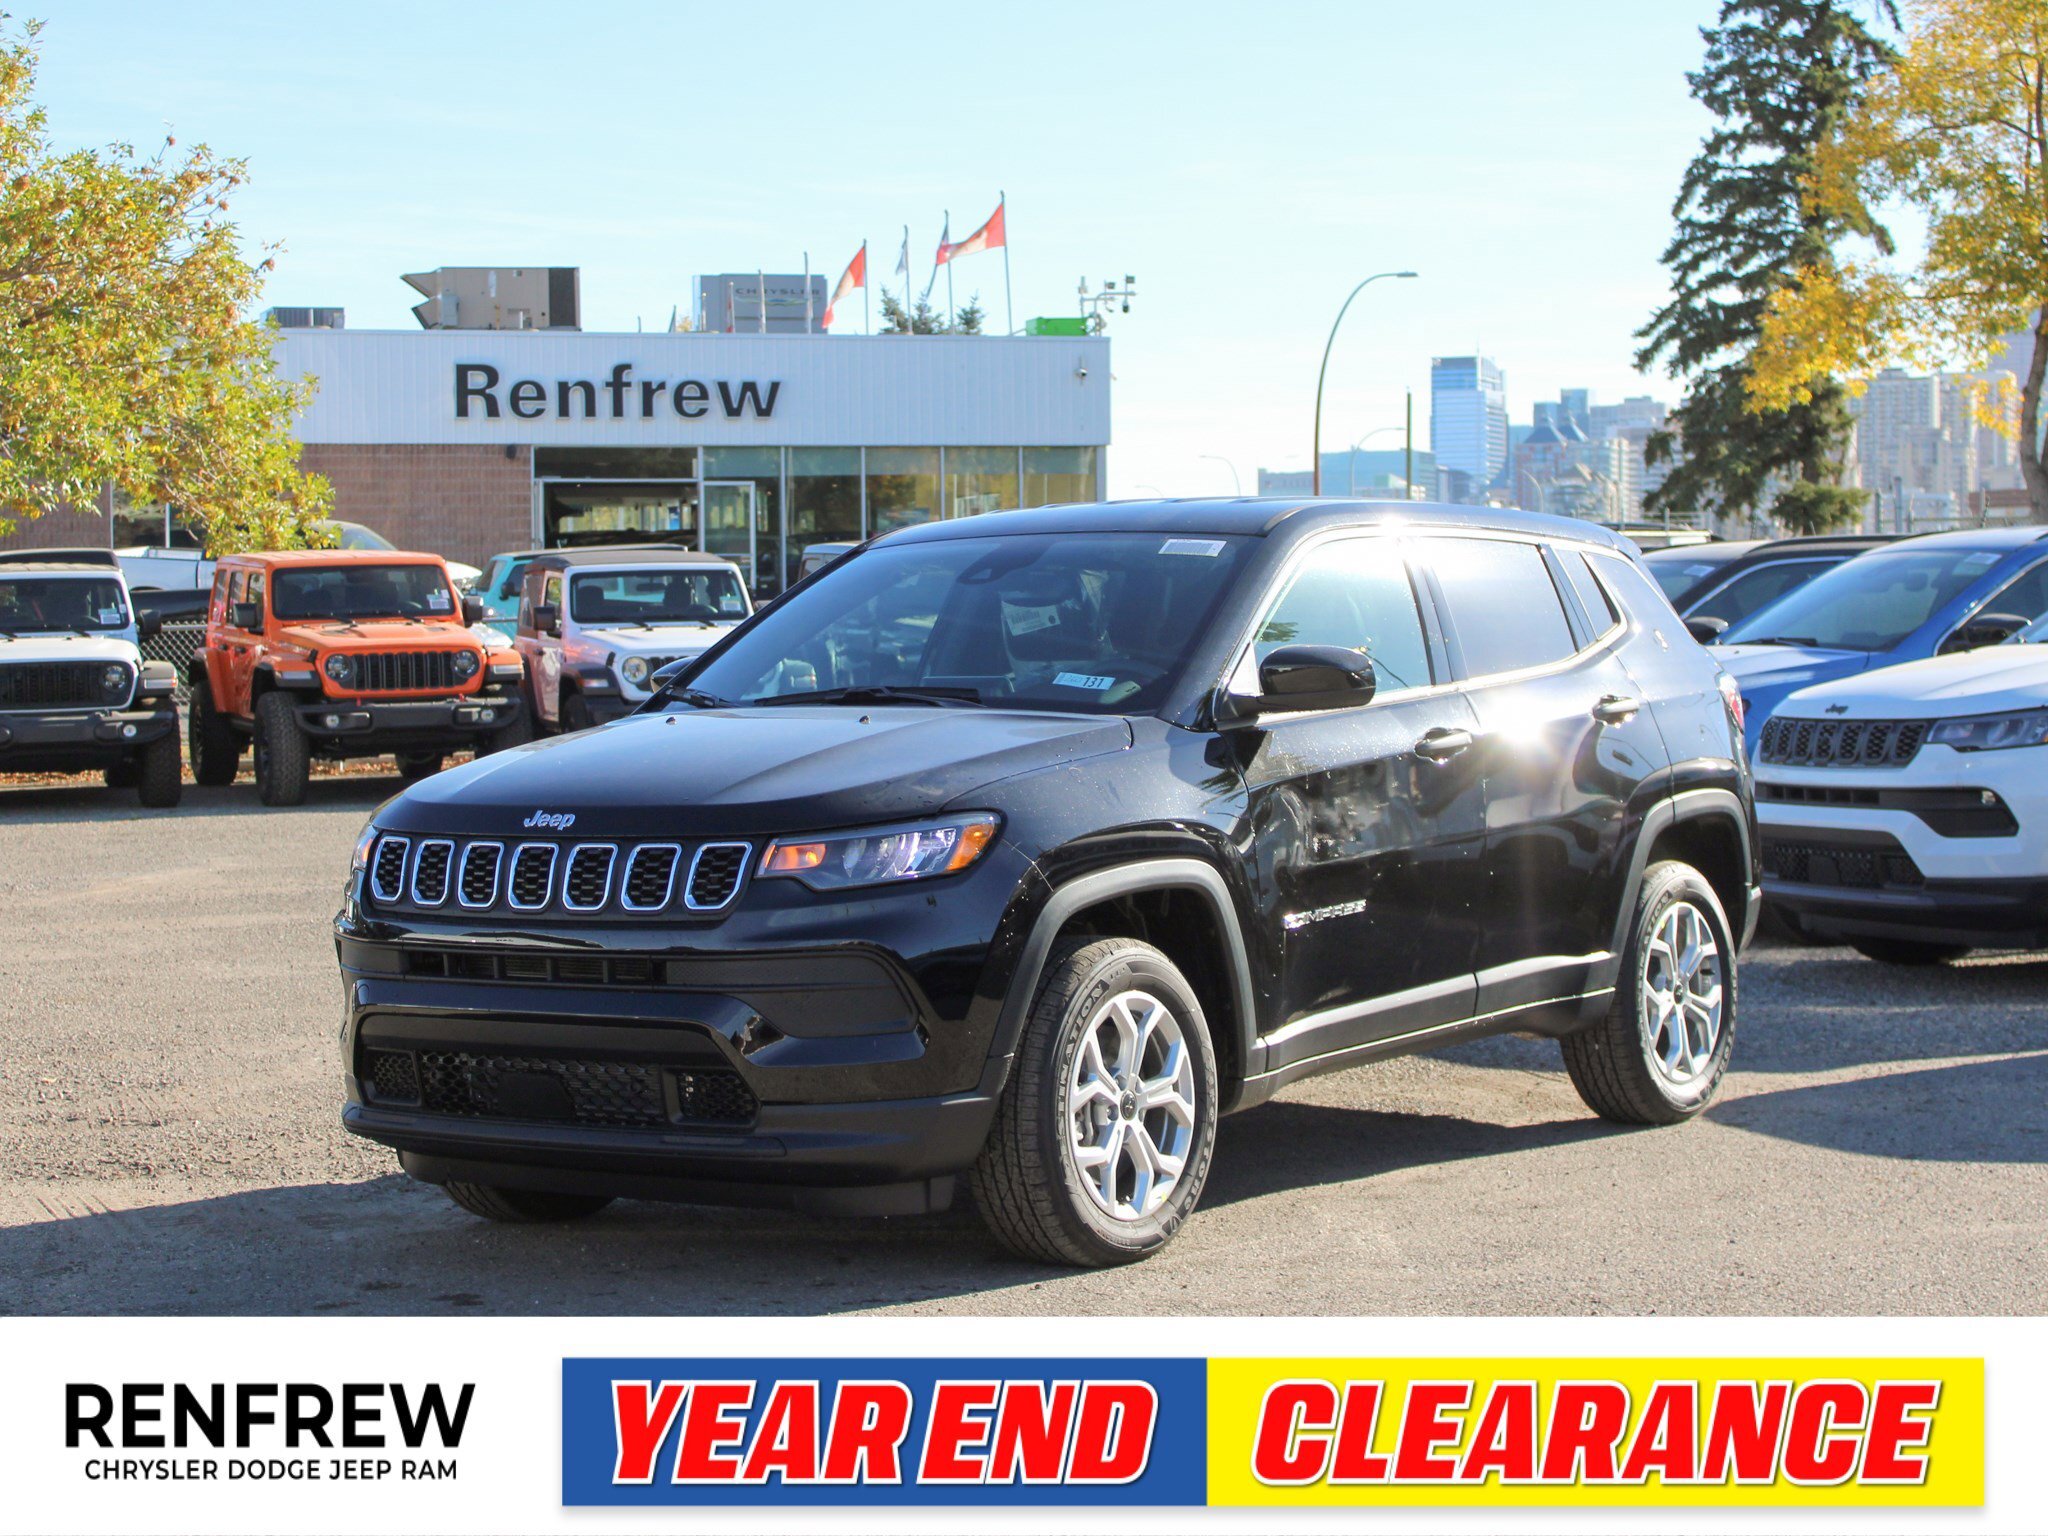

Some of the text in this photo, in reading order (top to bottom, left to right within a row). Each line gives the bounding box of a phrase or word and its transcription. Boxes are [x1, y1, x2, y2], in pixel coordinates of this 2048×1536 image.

[455, 363, 781, 420] Renfrew
[1082, 677, 1105, 688] 131
[523, 809, 576, 831] Jeep
